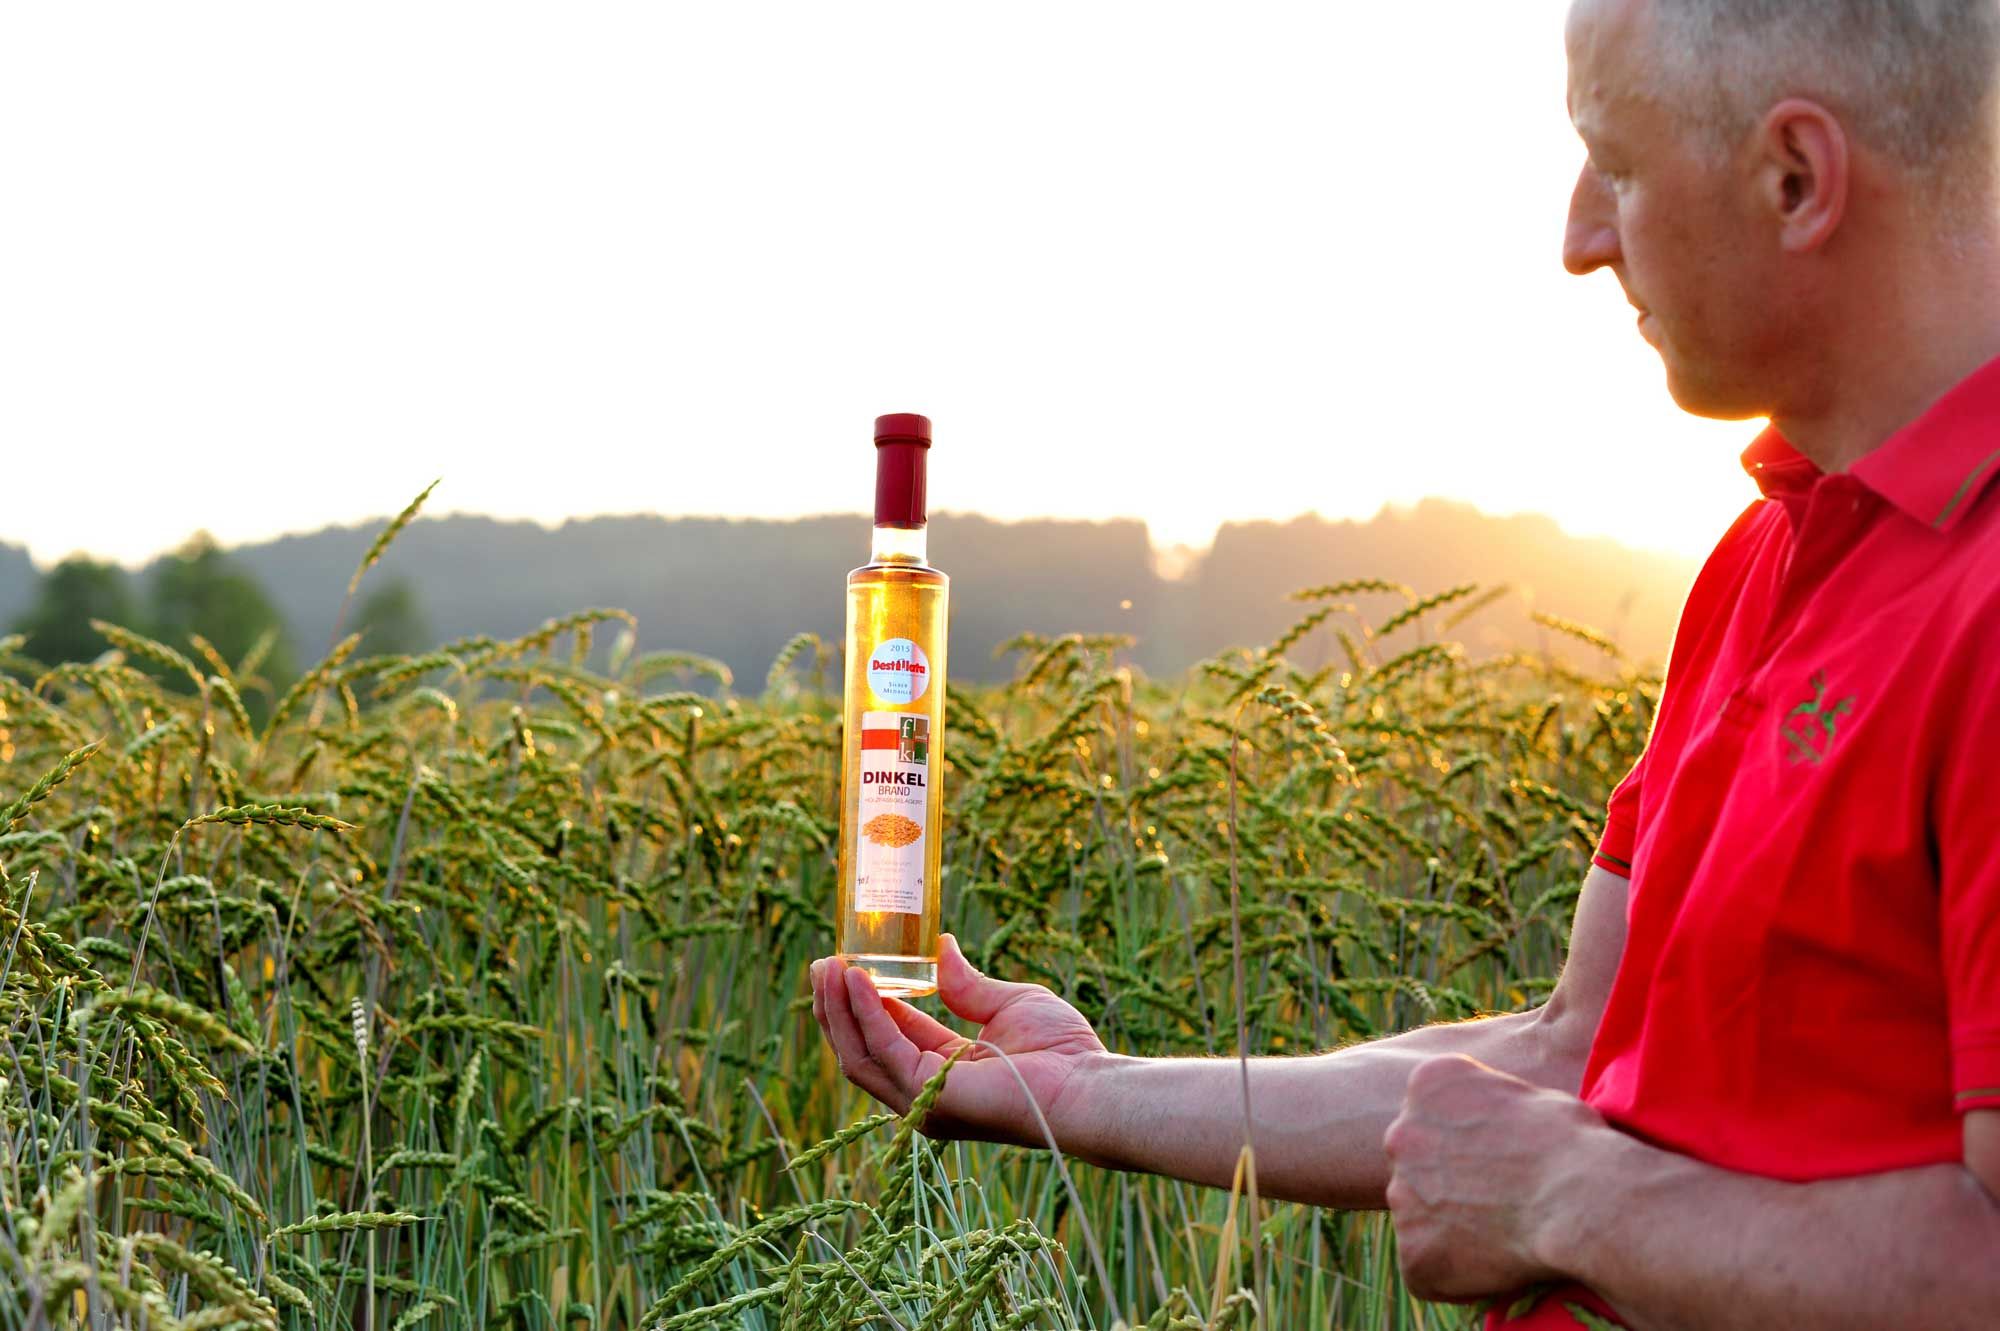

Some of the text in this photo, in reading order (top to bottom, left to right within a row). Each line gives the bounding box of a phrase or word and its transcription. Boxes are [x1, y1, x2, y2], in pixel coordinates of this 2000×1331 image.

[890, 645, 910, 653] 2015
[864, 771, 925, 786] DINKEL
[878, 786, 910, 796] BRAND
